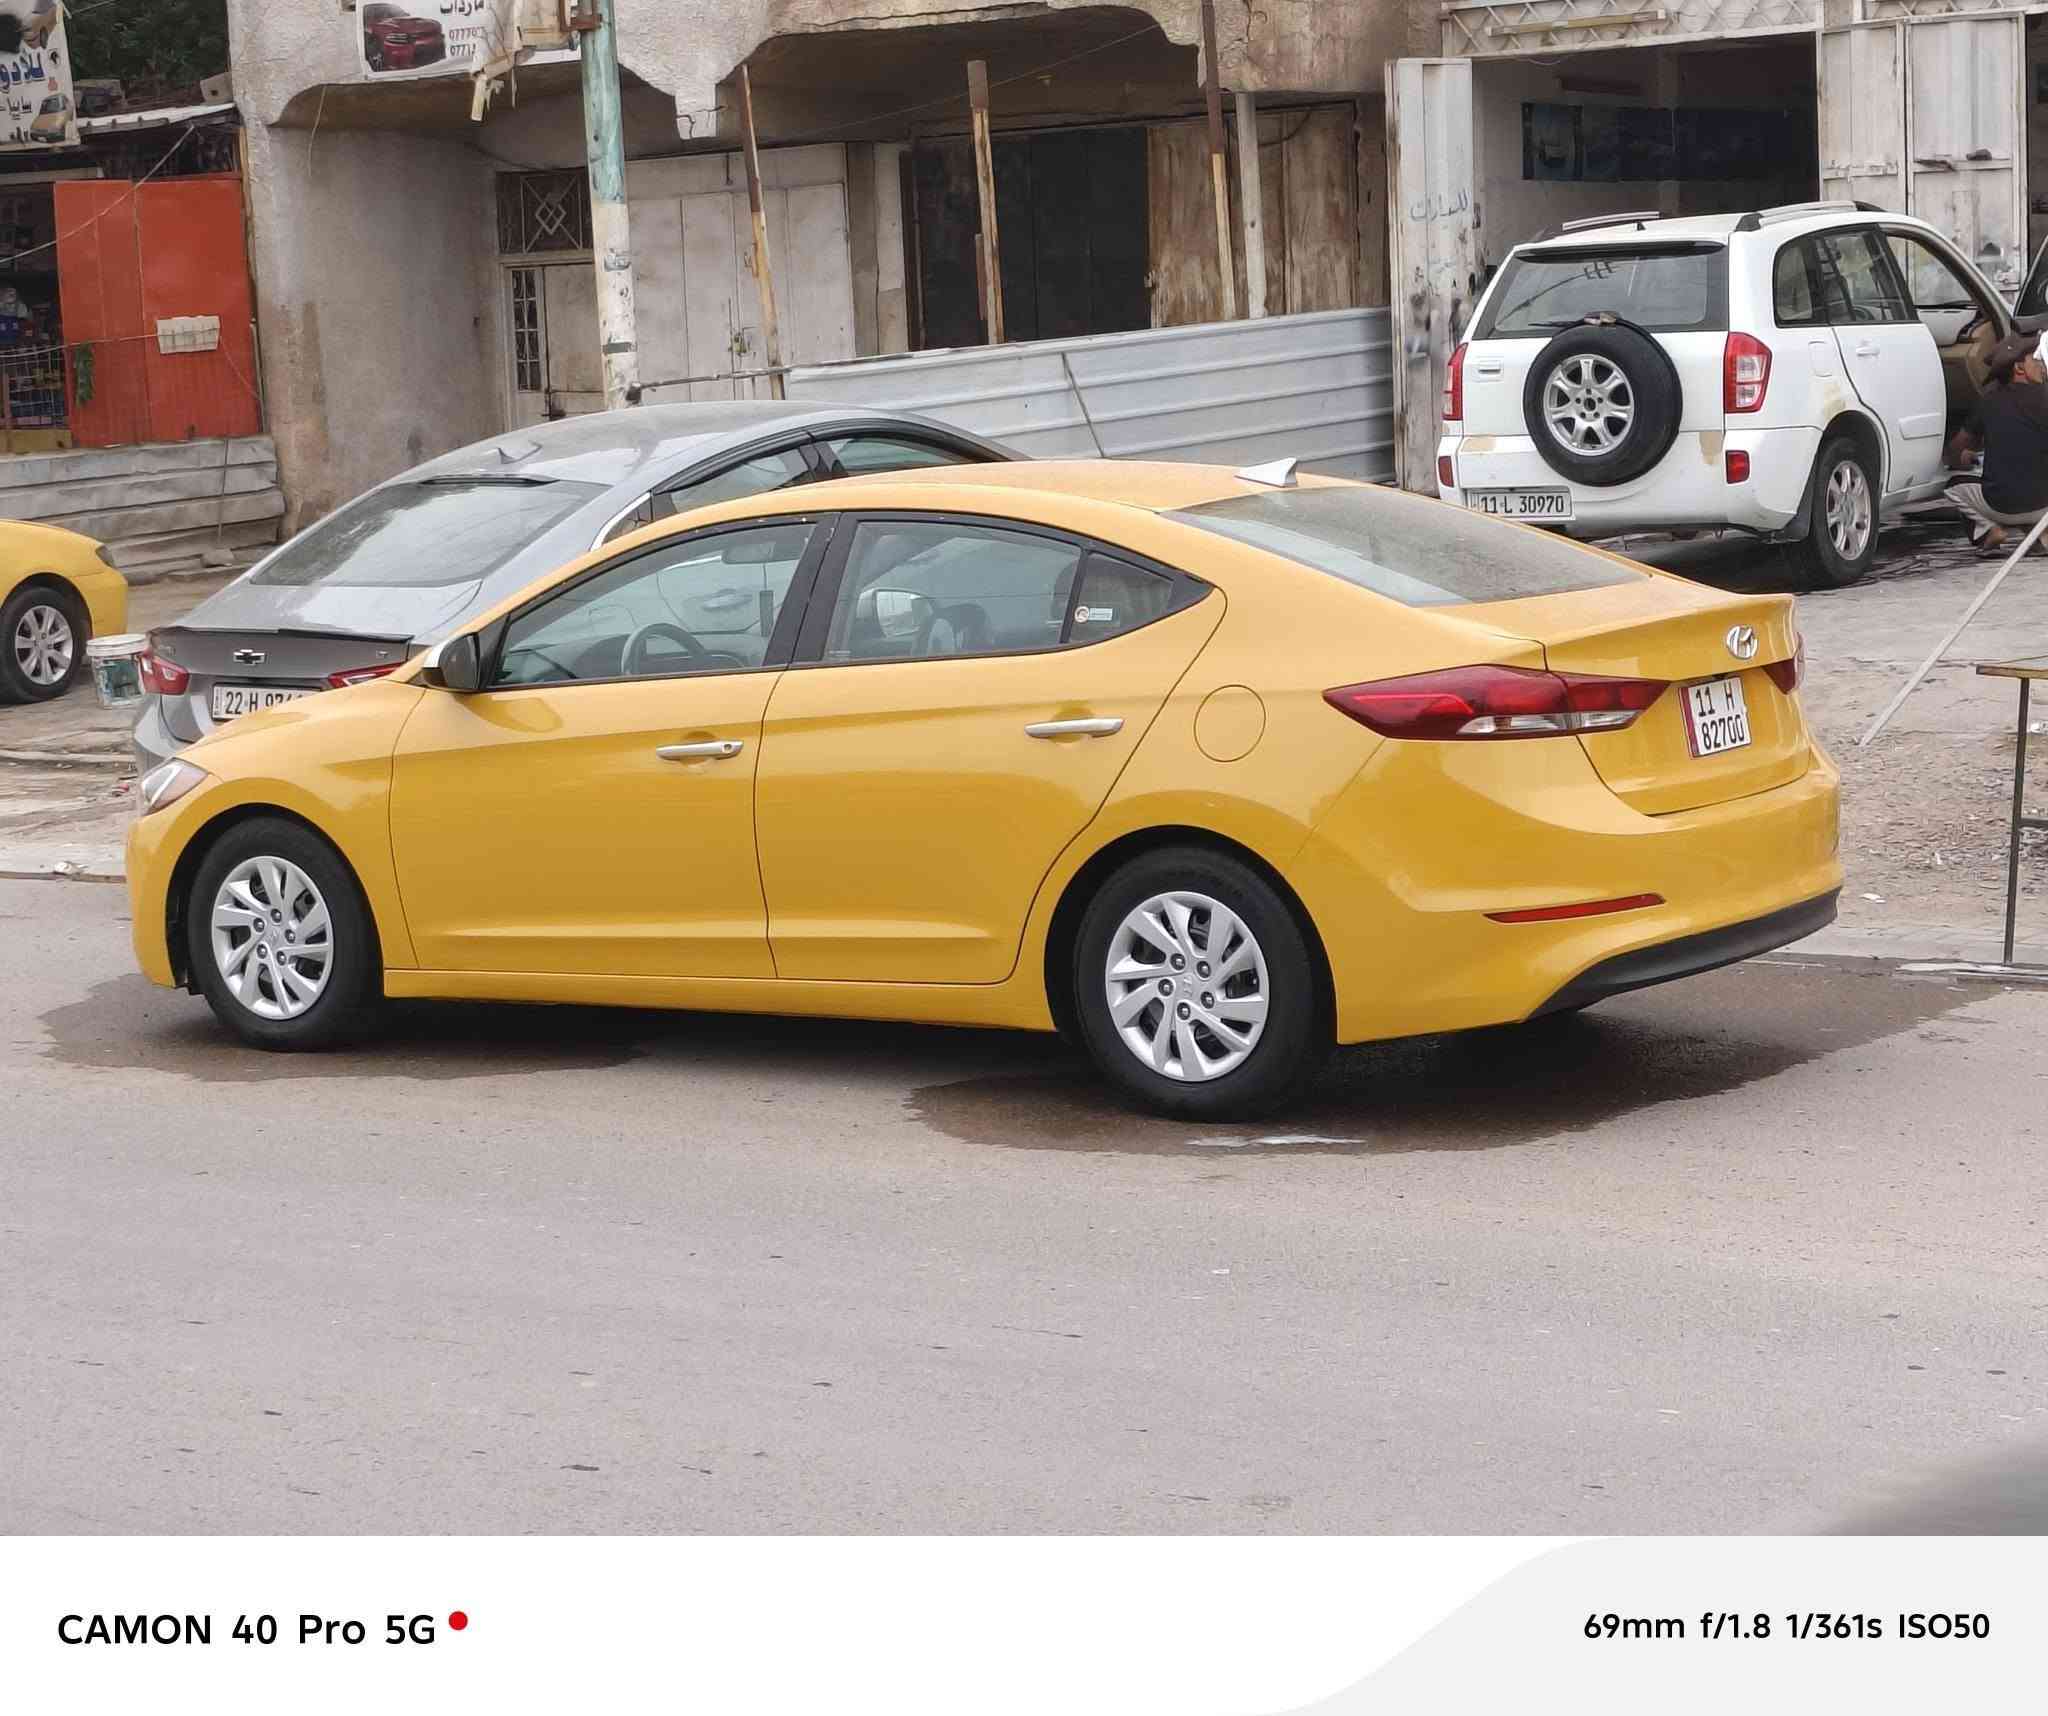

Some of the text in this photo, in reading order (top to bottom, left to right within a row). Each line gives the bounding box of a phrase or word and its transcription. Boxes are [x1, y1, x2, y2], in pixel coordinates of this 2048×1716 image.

[1480, 496, 1498, 513] 11
[1519, 495, 1565, 513] 30970
[224, 691, 243, 715] 22
[248, 692, 259, 712] H
[1695, 681, 1736, 717] 11 H
[1701, 714, 1745, 750] 82700
